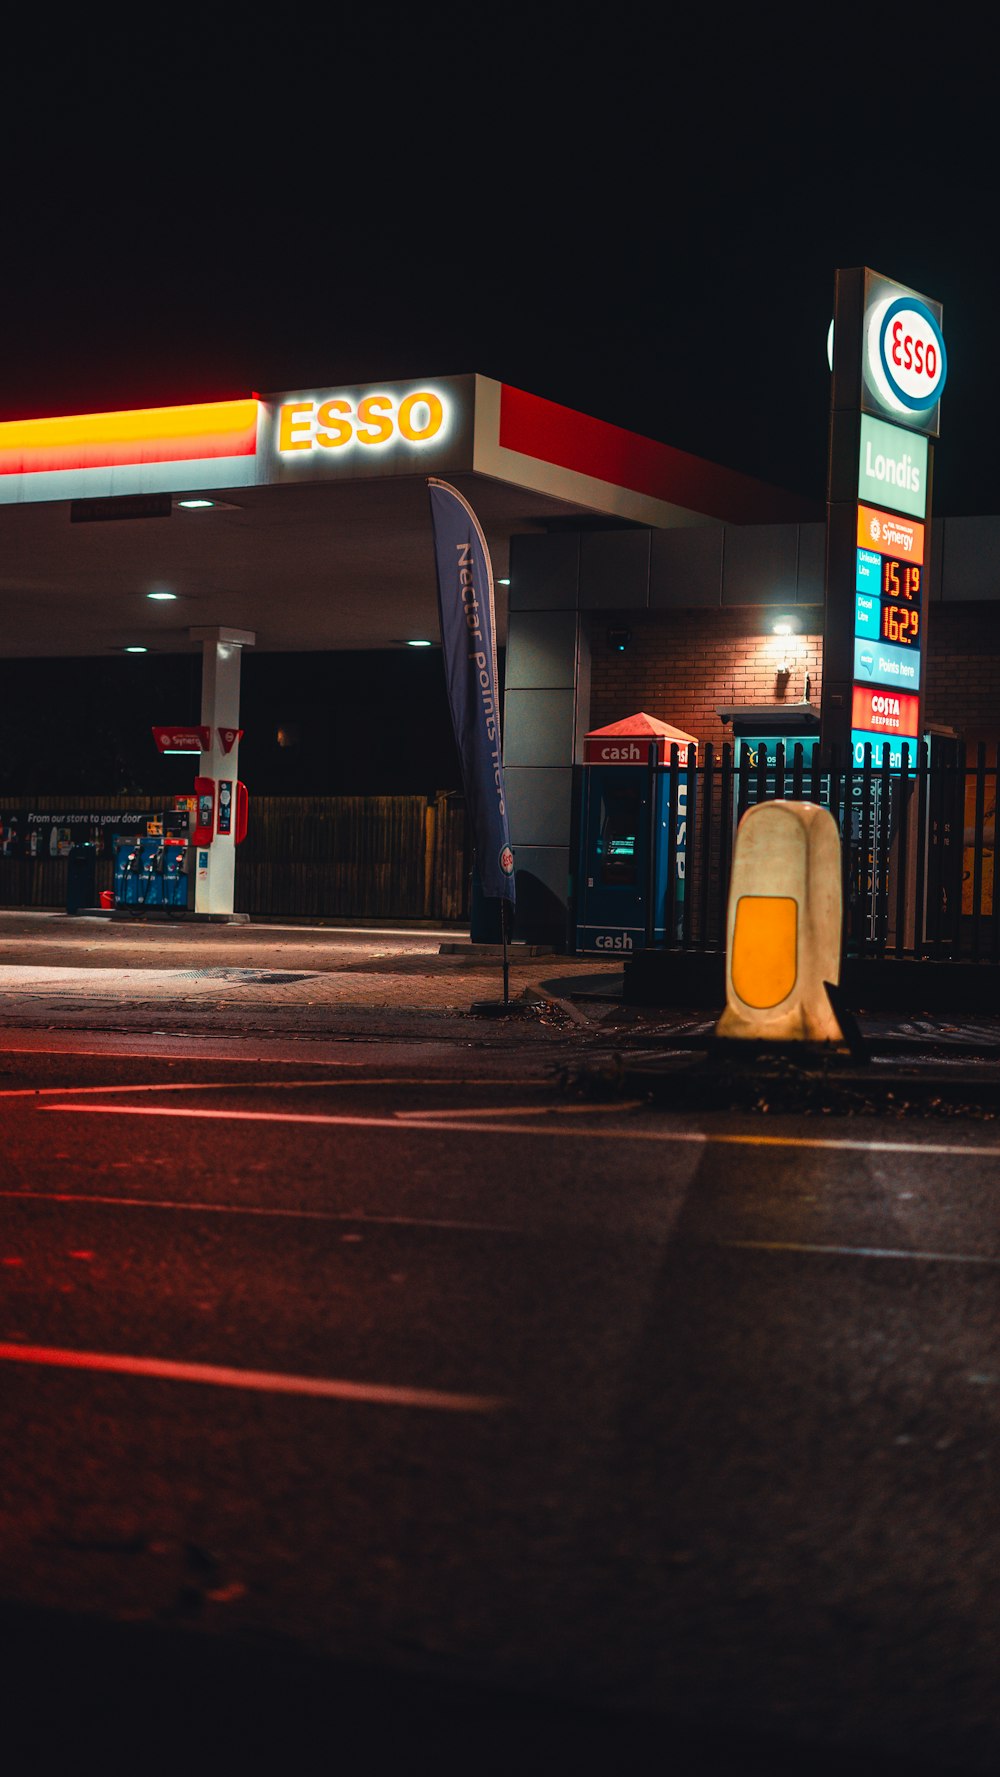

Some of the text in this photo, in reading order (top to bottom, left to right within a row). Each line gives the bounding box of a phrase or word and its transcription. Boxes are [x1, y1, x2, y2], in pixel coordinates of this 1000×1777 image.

[279, 392, 443, 451] ESSO
[865, 441, 920, 493] Londis
[882, 523, 914, 552] Synergy
[456, 543, 483, 642] Nectar
[879, 657, 900, 675] Points
[900, 661, 915, 678] here
[468, 651, 496, 742] points
[871, 695, 900, 716] COSTA
[601, 743, 641, 760] cash
[28, 813, 142, 826] From our store to your door
[596, 933, 632, 949] cash
